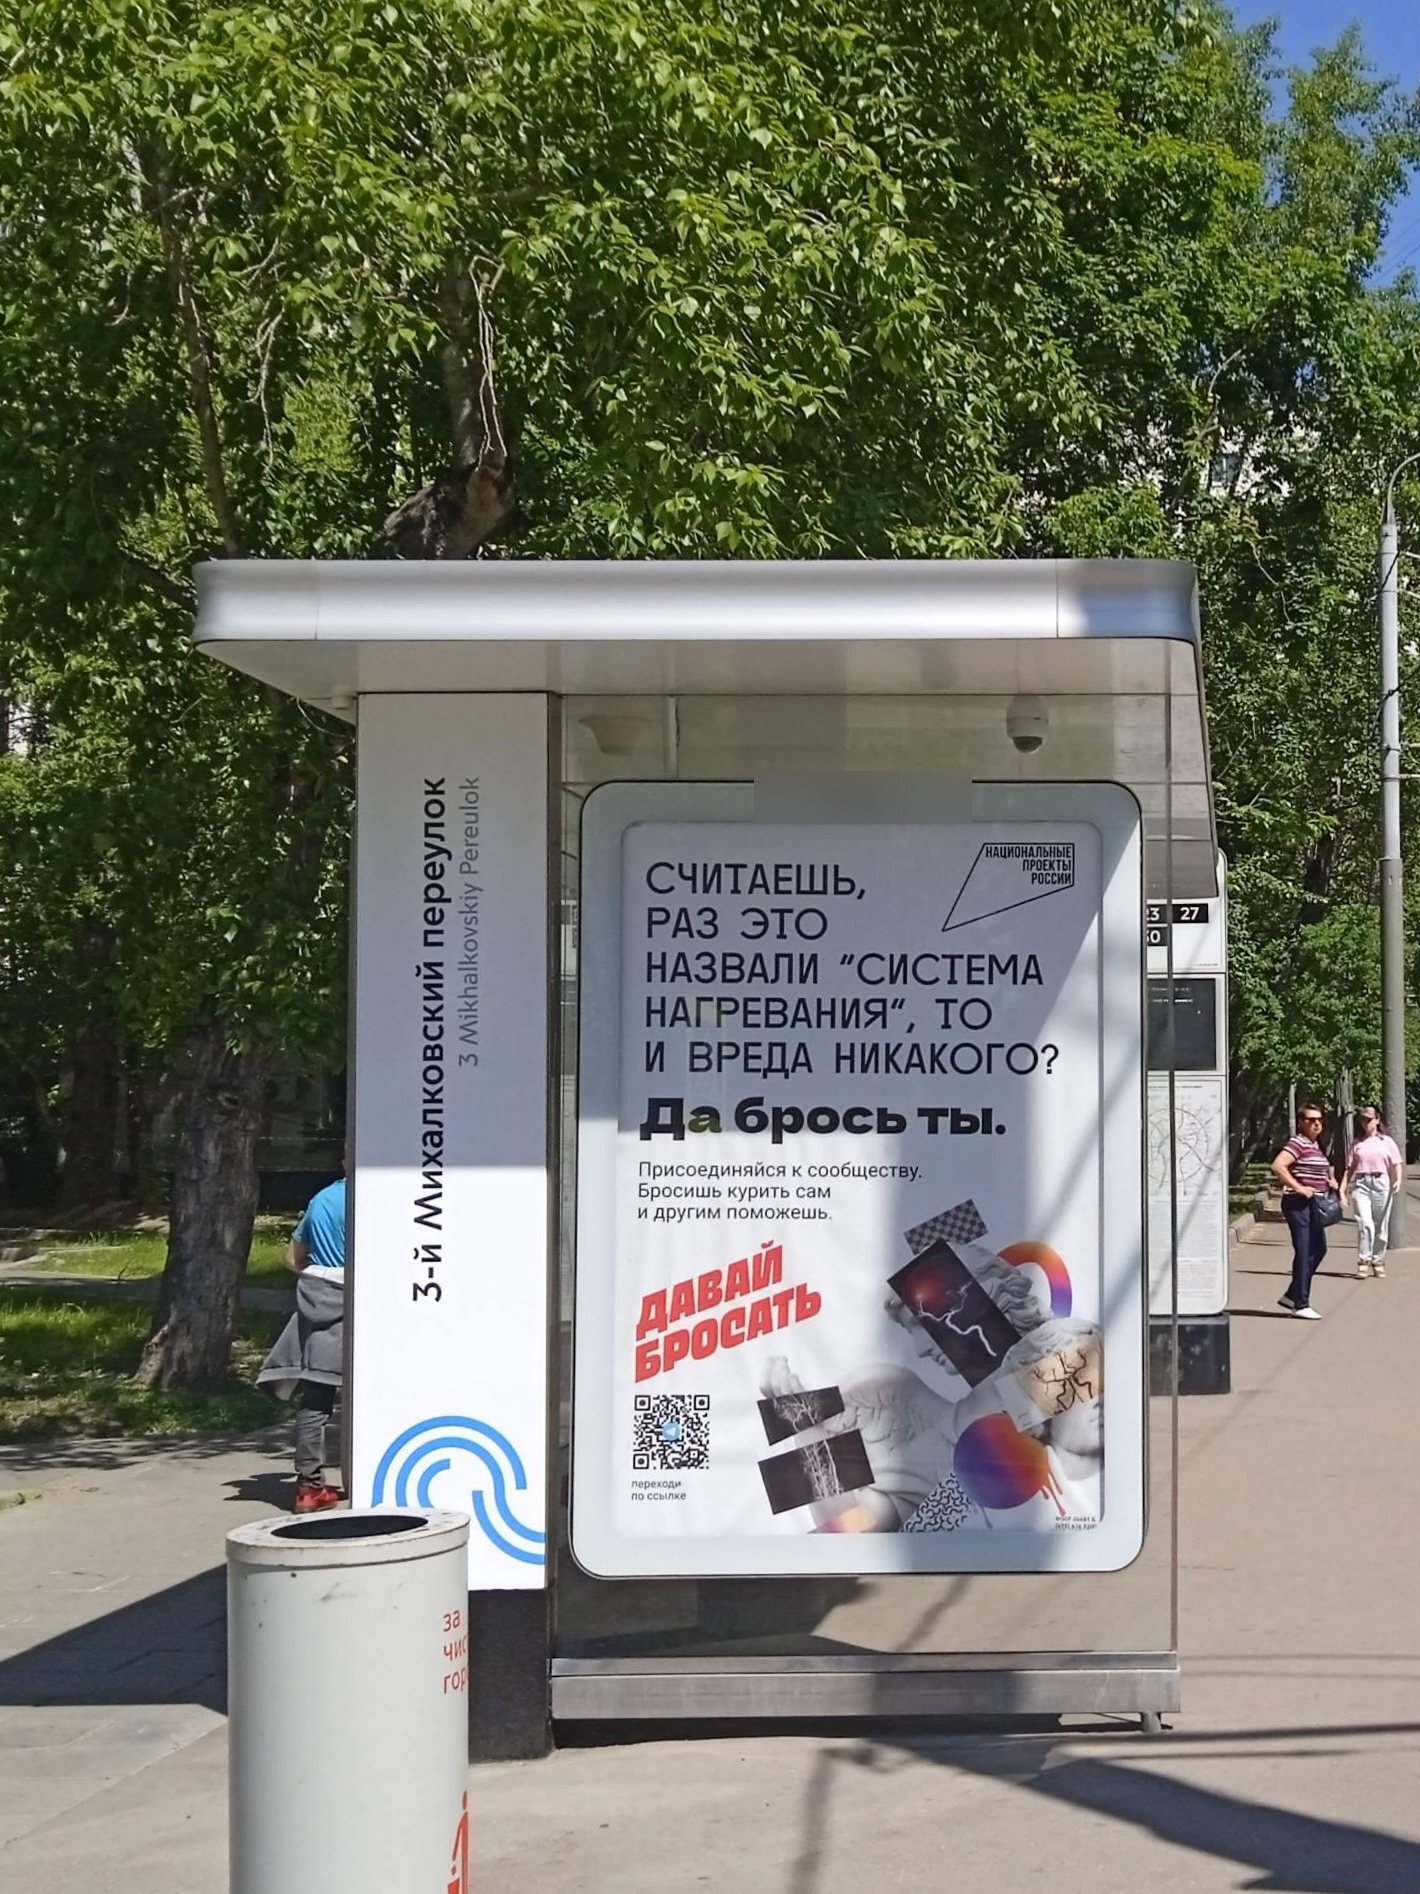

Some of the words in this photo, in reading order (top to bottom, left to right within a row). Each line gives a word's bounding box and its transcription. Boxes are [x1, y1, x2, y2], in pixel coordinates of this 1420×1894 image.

[458, 777, 480, 875] Pereulok
[422, 776, 453, 948] переулок
[985, 846, 1072, 859] НАЦИОНАЛЬНЫЕ
[1022, 859, 1071, 872] ПРОЕКТЫ
[645, 861, 866, 900] СЧИТАЕШЬ,
[1031, 872, 1071, 885] РОССИИ
[646, 907, 719, 940] РАЗ
[740, 907, 828, 941] ЭТО
[1180, 907, 1200, 921] 27
[457, 881, 484, 1043] Mikhalkovskiy
[645, 951, 819, 985] НАЗВАЛИ
[934, 997, 993, 1031] ТО
[458, 1053, 479, 1067] 3
[645, 1041, 665, 1073] И
[688, 1041, 814, 1080] ВРЕДА
[834, 1042, 1060, 1076] НИКАКОГО?
[413, 961, 446, 1231] Михалковский
[639, 1097, 722, 1141] Да
[734, 1096, 907, 1144] брось
[916, 1107, 1006, 1136] ты.
[639, 1161, 787, 1180] Присоединяйся
[791, 1165, 803, 1178] к
[807, 1162, 923, 1183] сообществу.
[638, 1183, 722, 1202] Бросишь
[726, 1186, 791, 1203] курить
[795, 1186, 832, 1200] сам
[637, 1205, 649, 1220] и
[653, 1204, 722, 1225] другим
[726, 1204, 833, 1221] поможешь.
[635, 1240, 783, 1342] ДАВАЙ
[634, 1283, 822, 1383] БРОСАТЬ
[631, 1480, 682, 1490] переходи
[631, 1492, 645, 1501] по
[647, 1492, 687, 1501] ссылке
[443, 1610, 460, 1632] за
[443, 1635, 468, 1661] чис
[443, 1667, 468, 1694] гор
